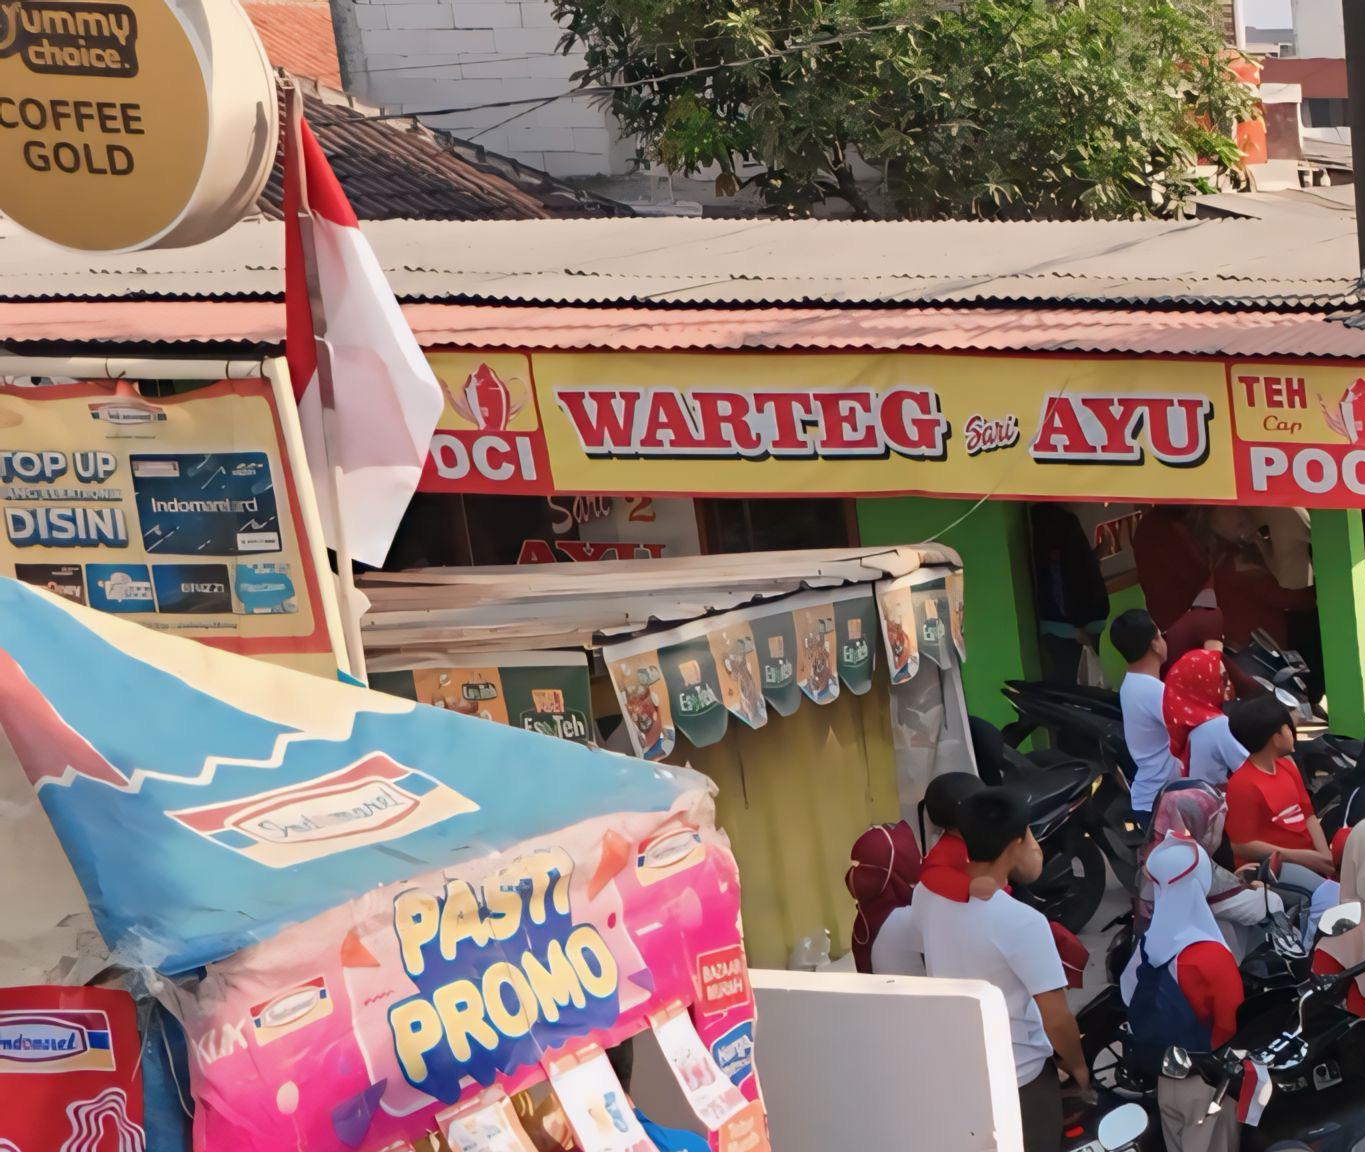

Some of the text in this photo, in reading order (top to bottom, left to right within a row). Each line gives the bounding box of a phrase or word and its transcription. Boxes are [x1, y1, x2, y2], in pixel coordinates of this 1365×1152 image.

[0, 2, 131, 49] Yummy
[27, 38, 131, 70] choice.
[0, 96, 146, 136] COFFEE
[23, 139, 135, 177] GOLD
[1239, 375, 1307, 410] TEH
[555, 387, 1209, 460] WARTEG Sari AYU
[1263, 414, 1303, 436] Cap
[0, 451, 117, 481] TOP UP
[429, 433, 538, 481] OCI
[5, 507, 128, 543] DISINI
[553, 713, 585, 739] Teh
[394, 845, 575, 976] PASTI
[388, 926, 619, 1082] PROMO
